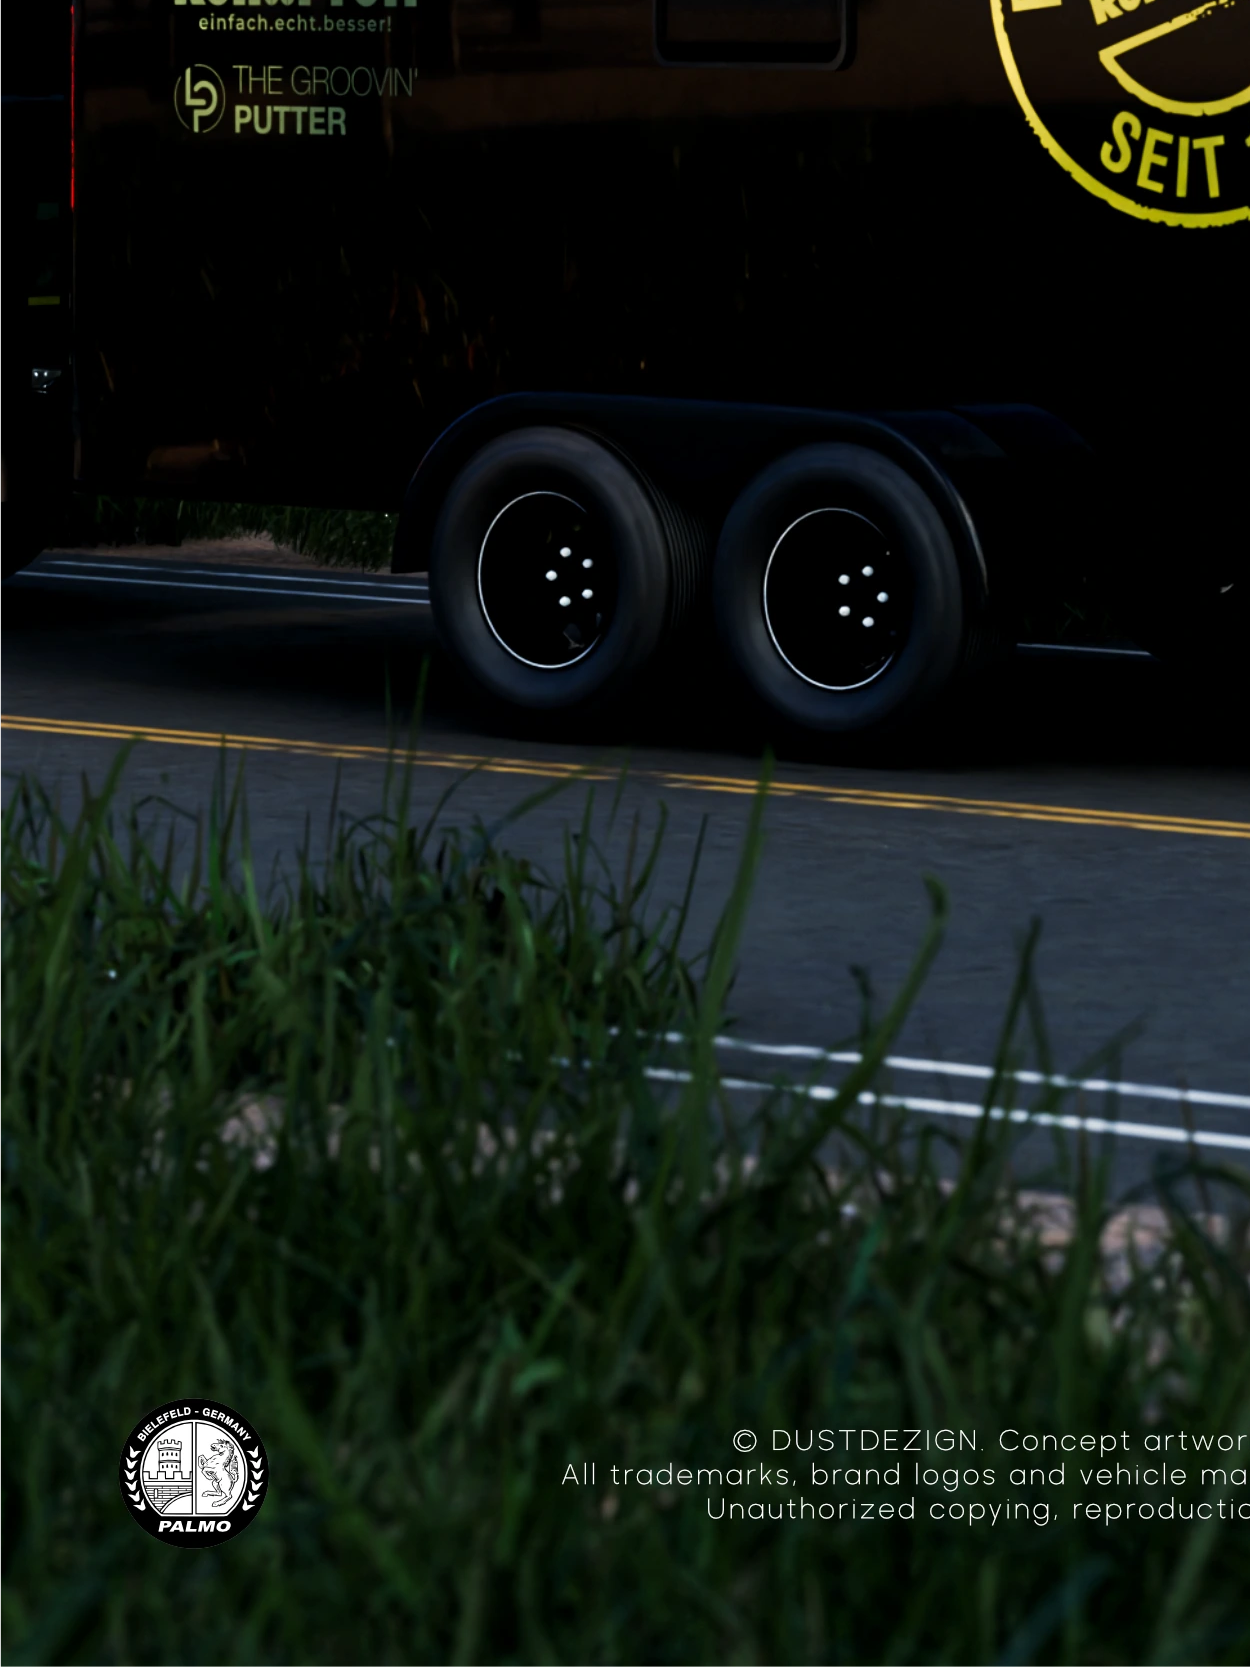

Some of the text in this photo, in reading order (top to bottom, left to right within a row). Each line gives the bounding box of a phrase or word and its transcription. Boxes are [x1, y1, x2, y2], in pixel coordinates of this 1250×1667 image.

[198, 13, 392, 32] einfach.echt.besser!
[232, 65, 418, 97] THE GROOVIN'
[234, 105, 346, 135] PUTTER
[1100, 111, 1226, 198] SEIT
